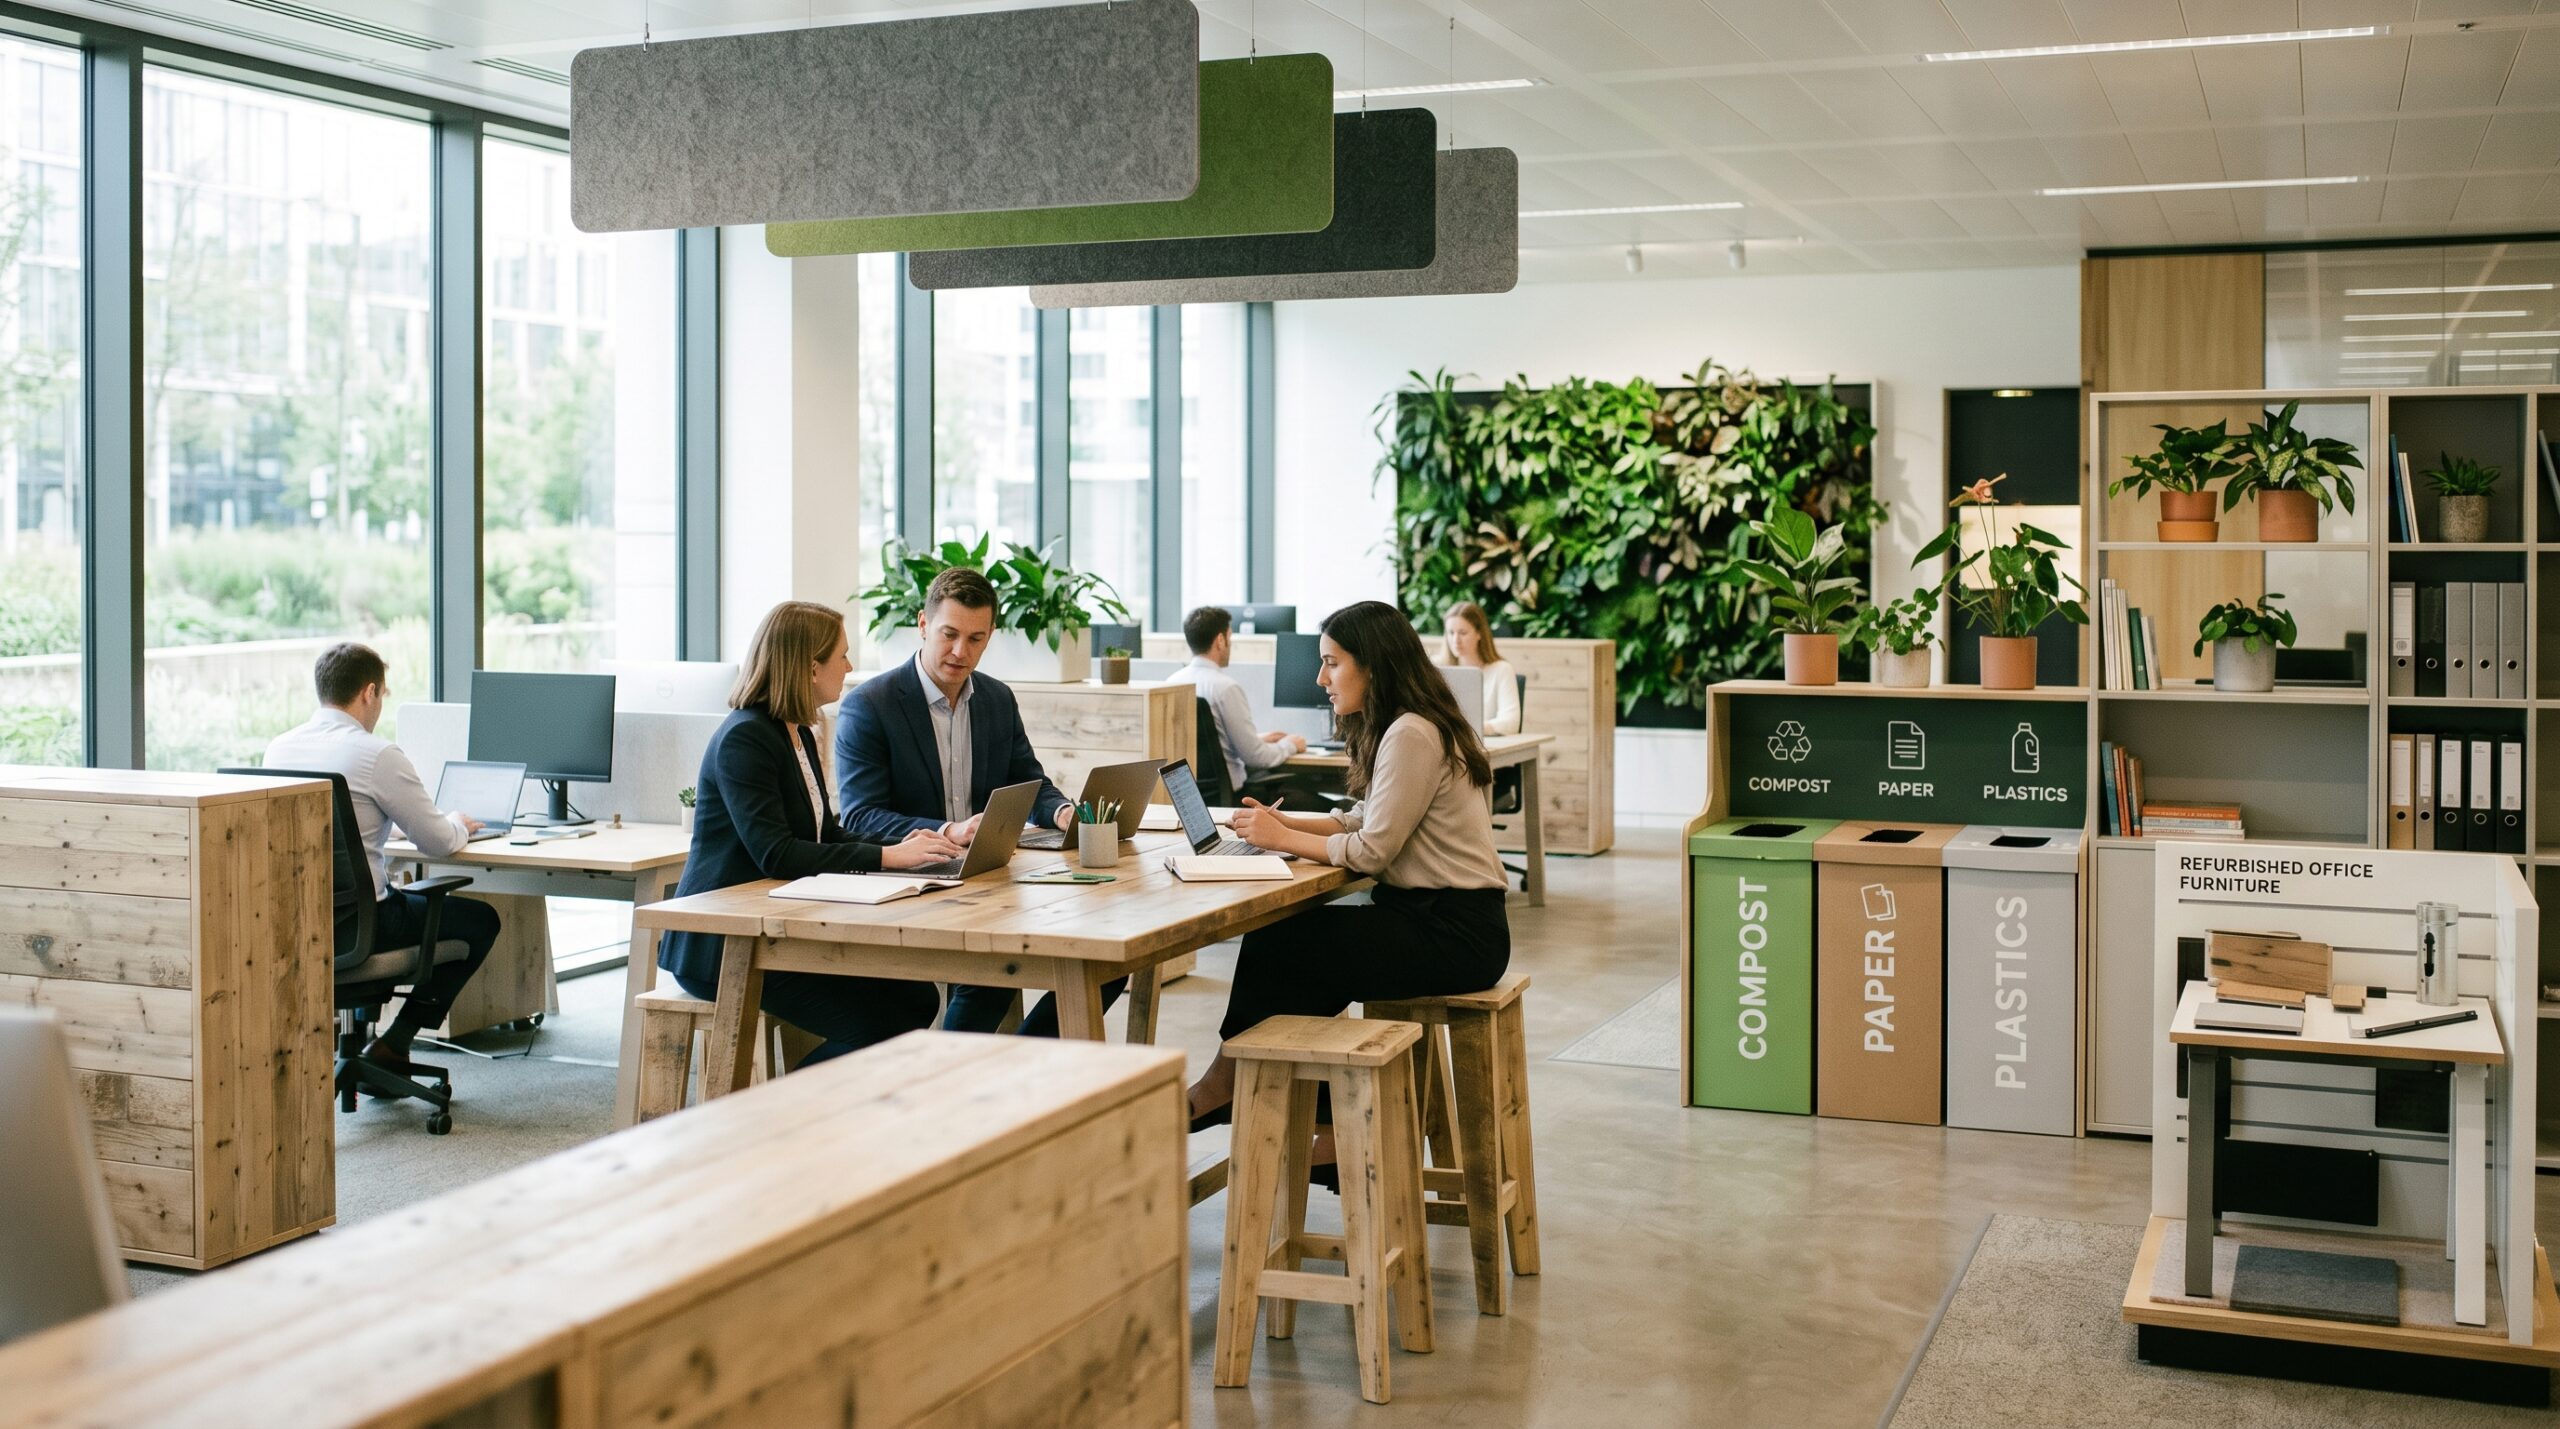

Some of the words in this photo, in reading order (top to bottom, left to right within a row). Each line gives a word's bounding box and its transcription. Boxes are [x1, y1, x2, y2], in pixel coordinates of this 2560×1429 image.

[1748, 777, 1831, 794] COMPOST
[1878, 781, 1934, 797] PAPER
[1983, 784, 2068, 802] PLASTICS
[2180, 856, 2304, 875] REFURBISHED
[2309, 861, 2374, 878] OFFICE
[2180, 876, 2281, 894] FURNITURE
[1738, 876, 1768, 1060] COMPOST
[1864, 930, 1895, 1053] PAPER
[1995, 896, 2028, 1089] PLASTICS
